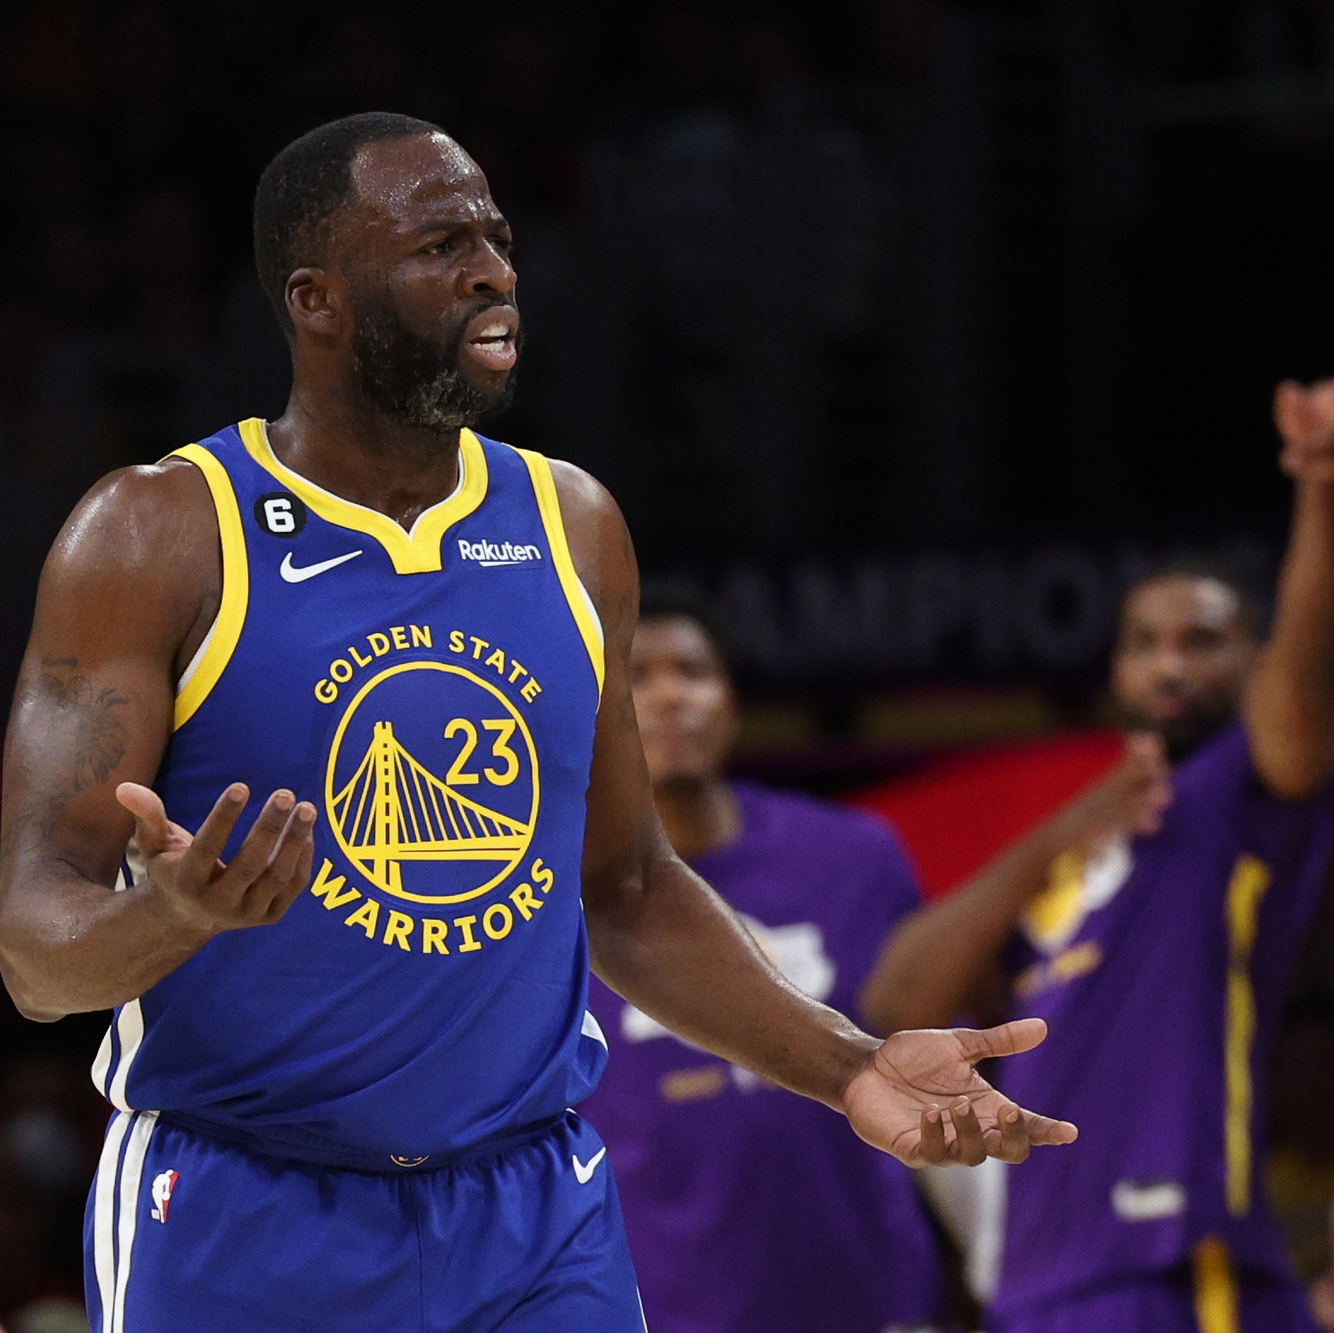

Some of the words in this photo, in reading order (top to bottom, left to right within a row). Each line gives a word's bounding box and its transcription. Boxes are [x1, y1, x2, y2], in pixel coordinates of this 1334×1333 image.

[264, 498, 296, 533] 6
[457, 539, 542, 561] Rakuten
[314, 624, 433, 704] GOLDEN
[448, 630, 543, 704] STATE
[444, 717, 520, 786] 23
[310, 857, 555, 955] WARRIORS
